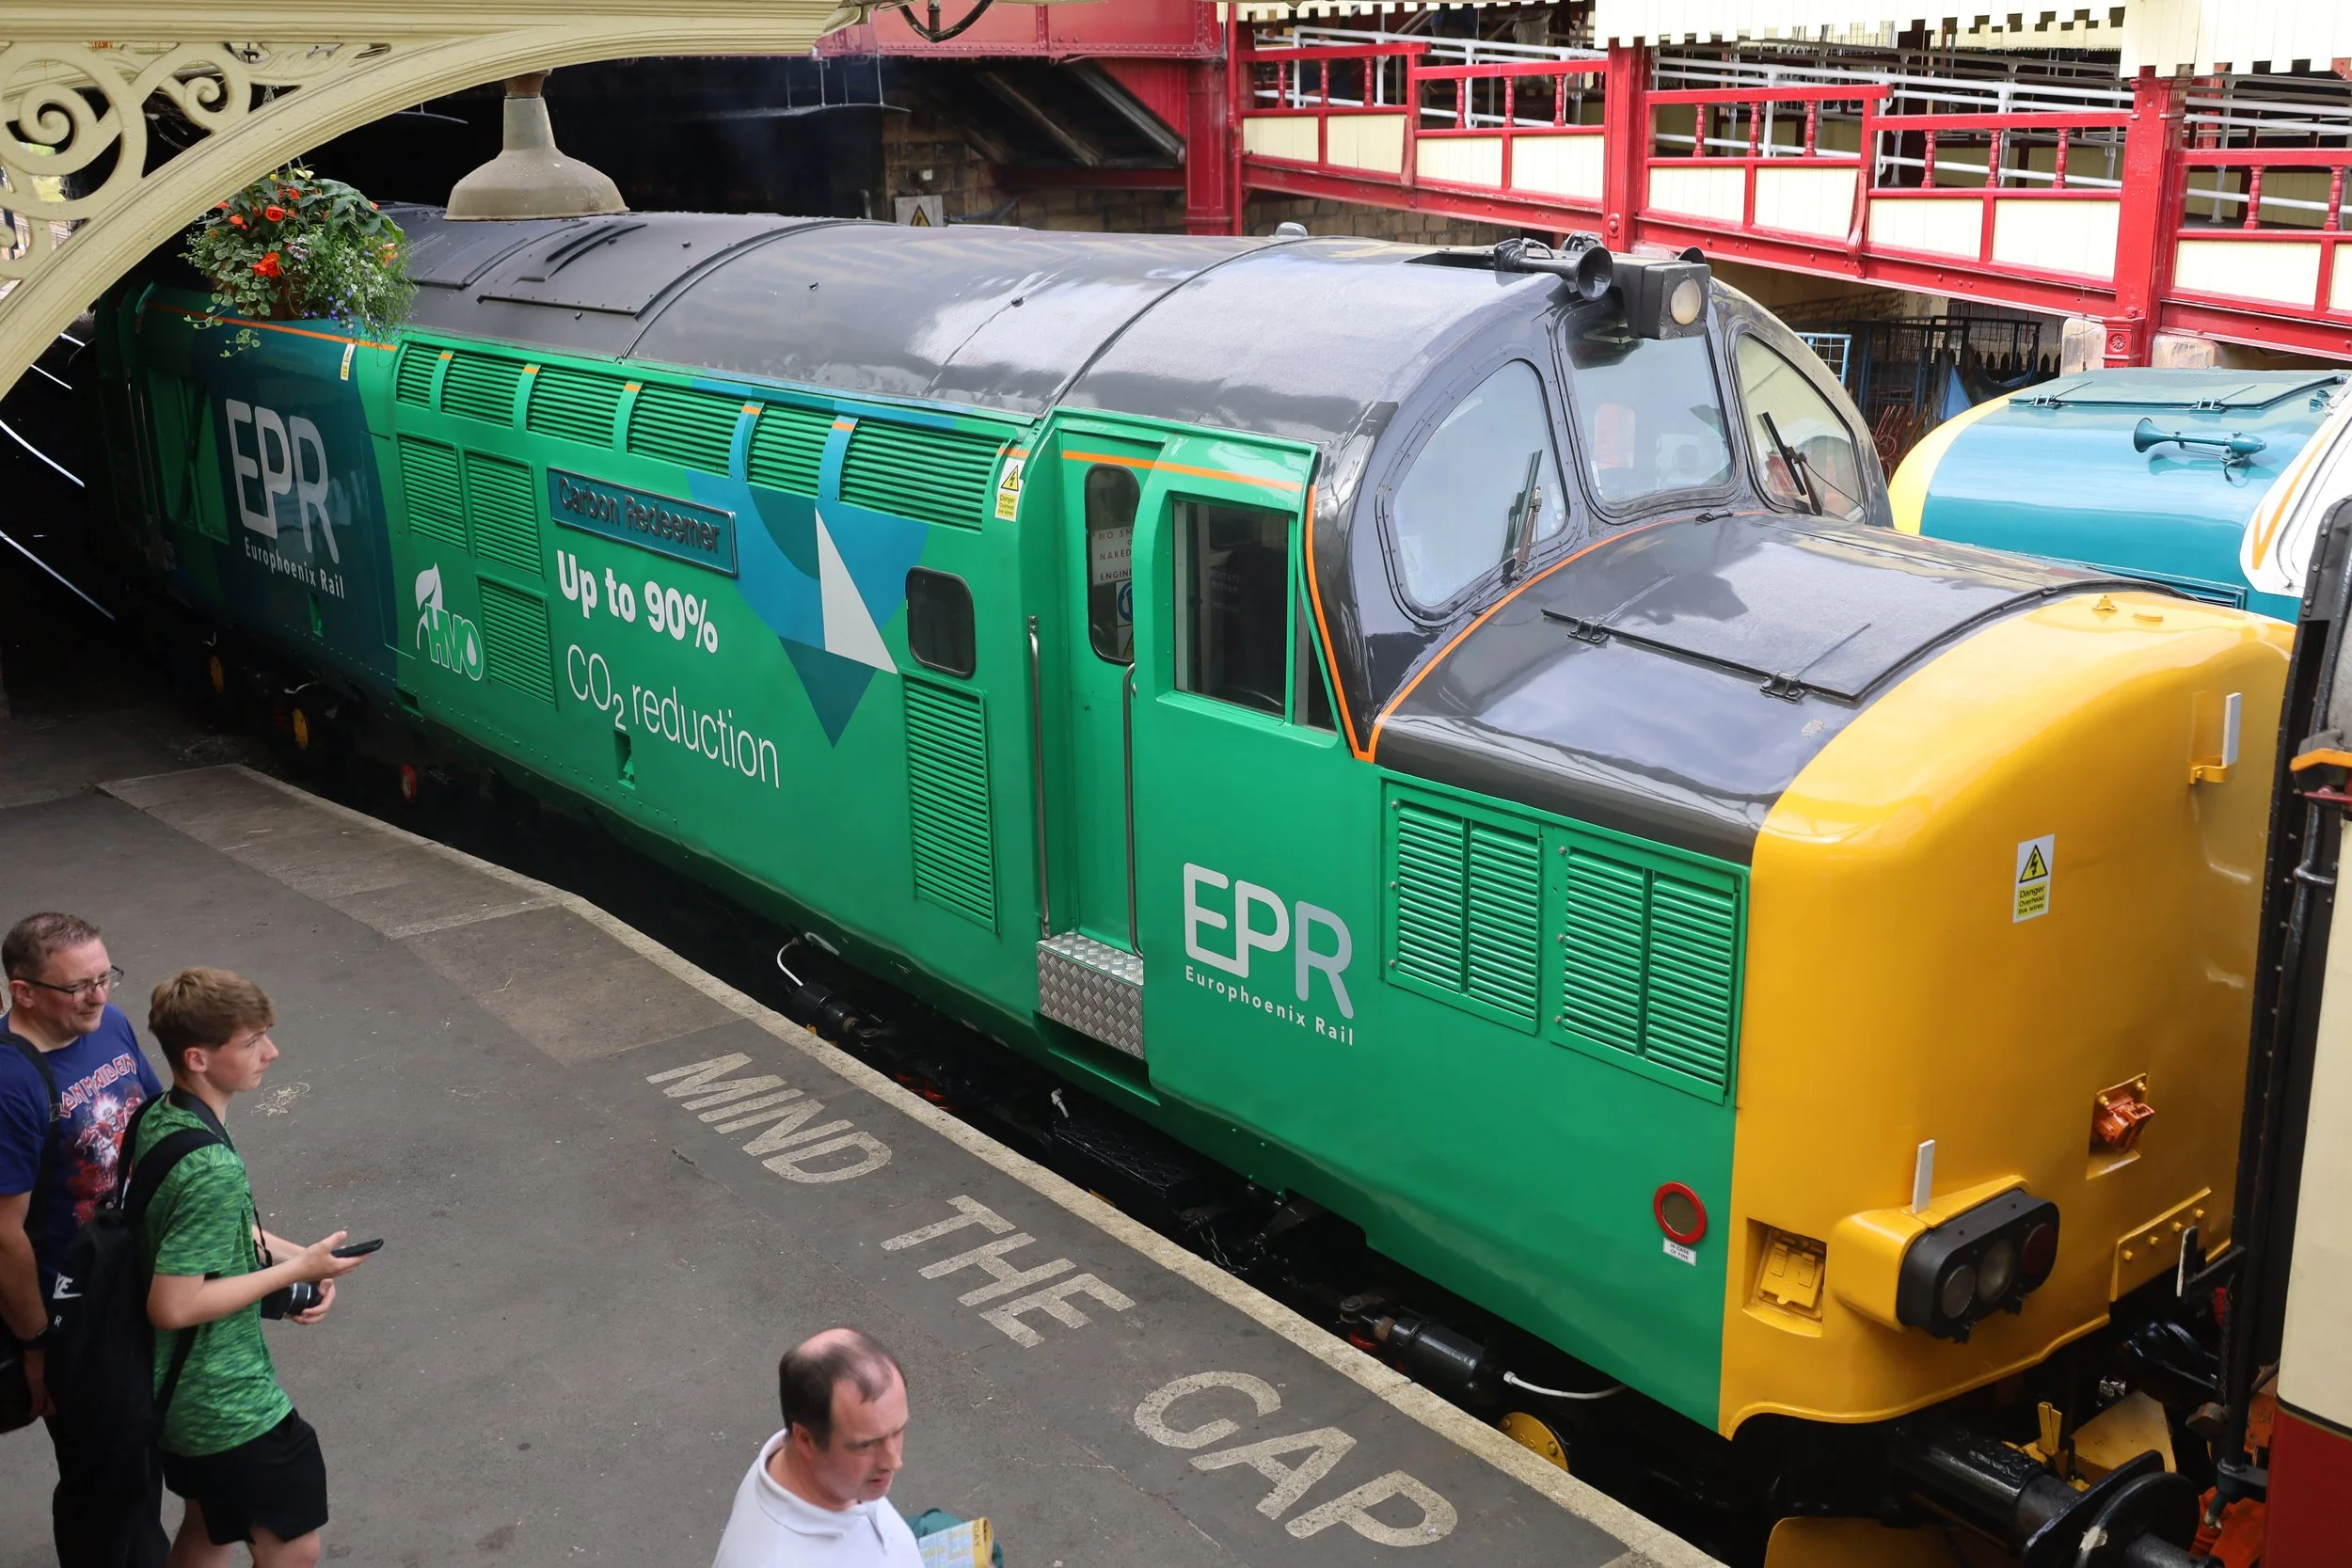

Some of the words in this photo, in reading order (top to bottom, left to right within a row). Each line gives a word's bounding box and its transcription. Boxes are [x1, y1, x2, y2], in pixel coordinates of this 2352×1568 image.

[226, 398, 340, 564] EPR
[559, 477, 620, 525] Carbon
[625, 495, 721, 553] Redeemer
[245, 536, 317, 587] Europhoenix
[320, 568, 344, 599] Rail
[1099, 531, 1114, 540] NO
[1099, 548, 1132, 561] NAKED
[557, 549, 597, 619] Up
[605, 567, 636, 623] to
[644, 580, 719, 654] 90%
[1100, 569, 1133, 581] ENGIN
[425, 603, 484, 681] HVO
[632, 685, 780, 789] reduction
[2019, 885, 2045, 898] Danger
[1184, 863, 1354, 1019] EPR
[1185, 965, 1305, 1027] Europhoenix
[1315, 1016, 1353, 1046] Rail
[646, 1053, 892, 1183] MIND
[880, 1195, 1136, 1348] THE
[1134, 1371, 1458, 1547] GAP
